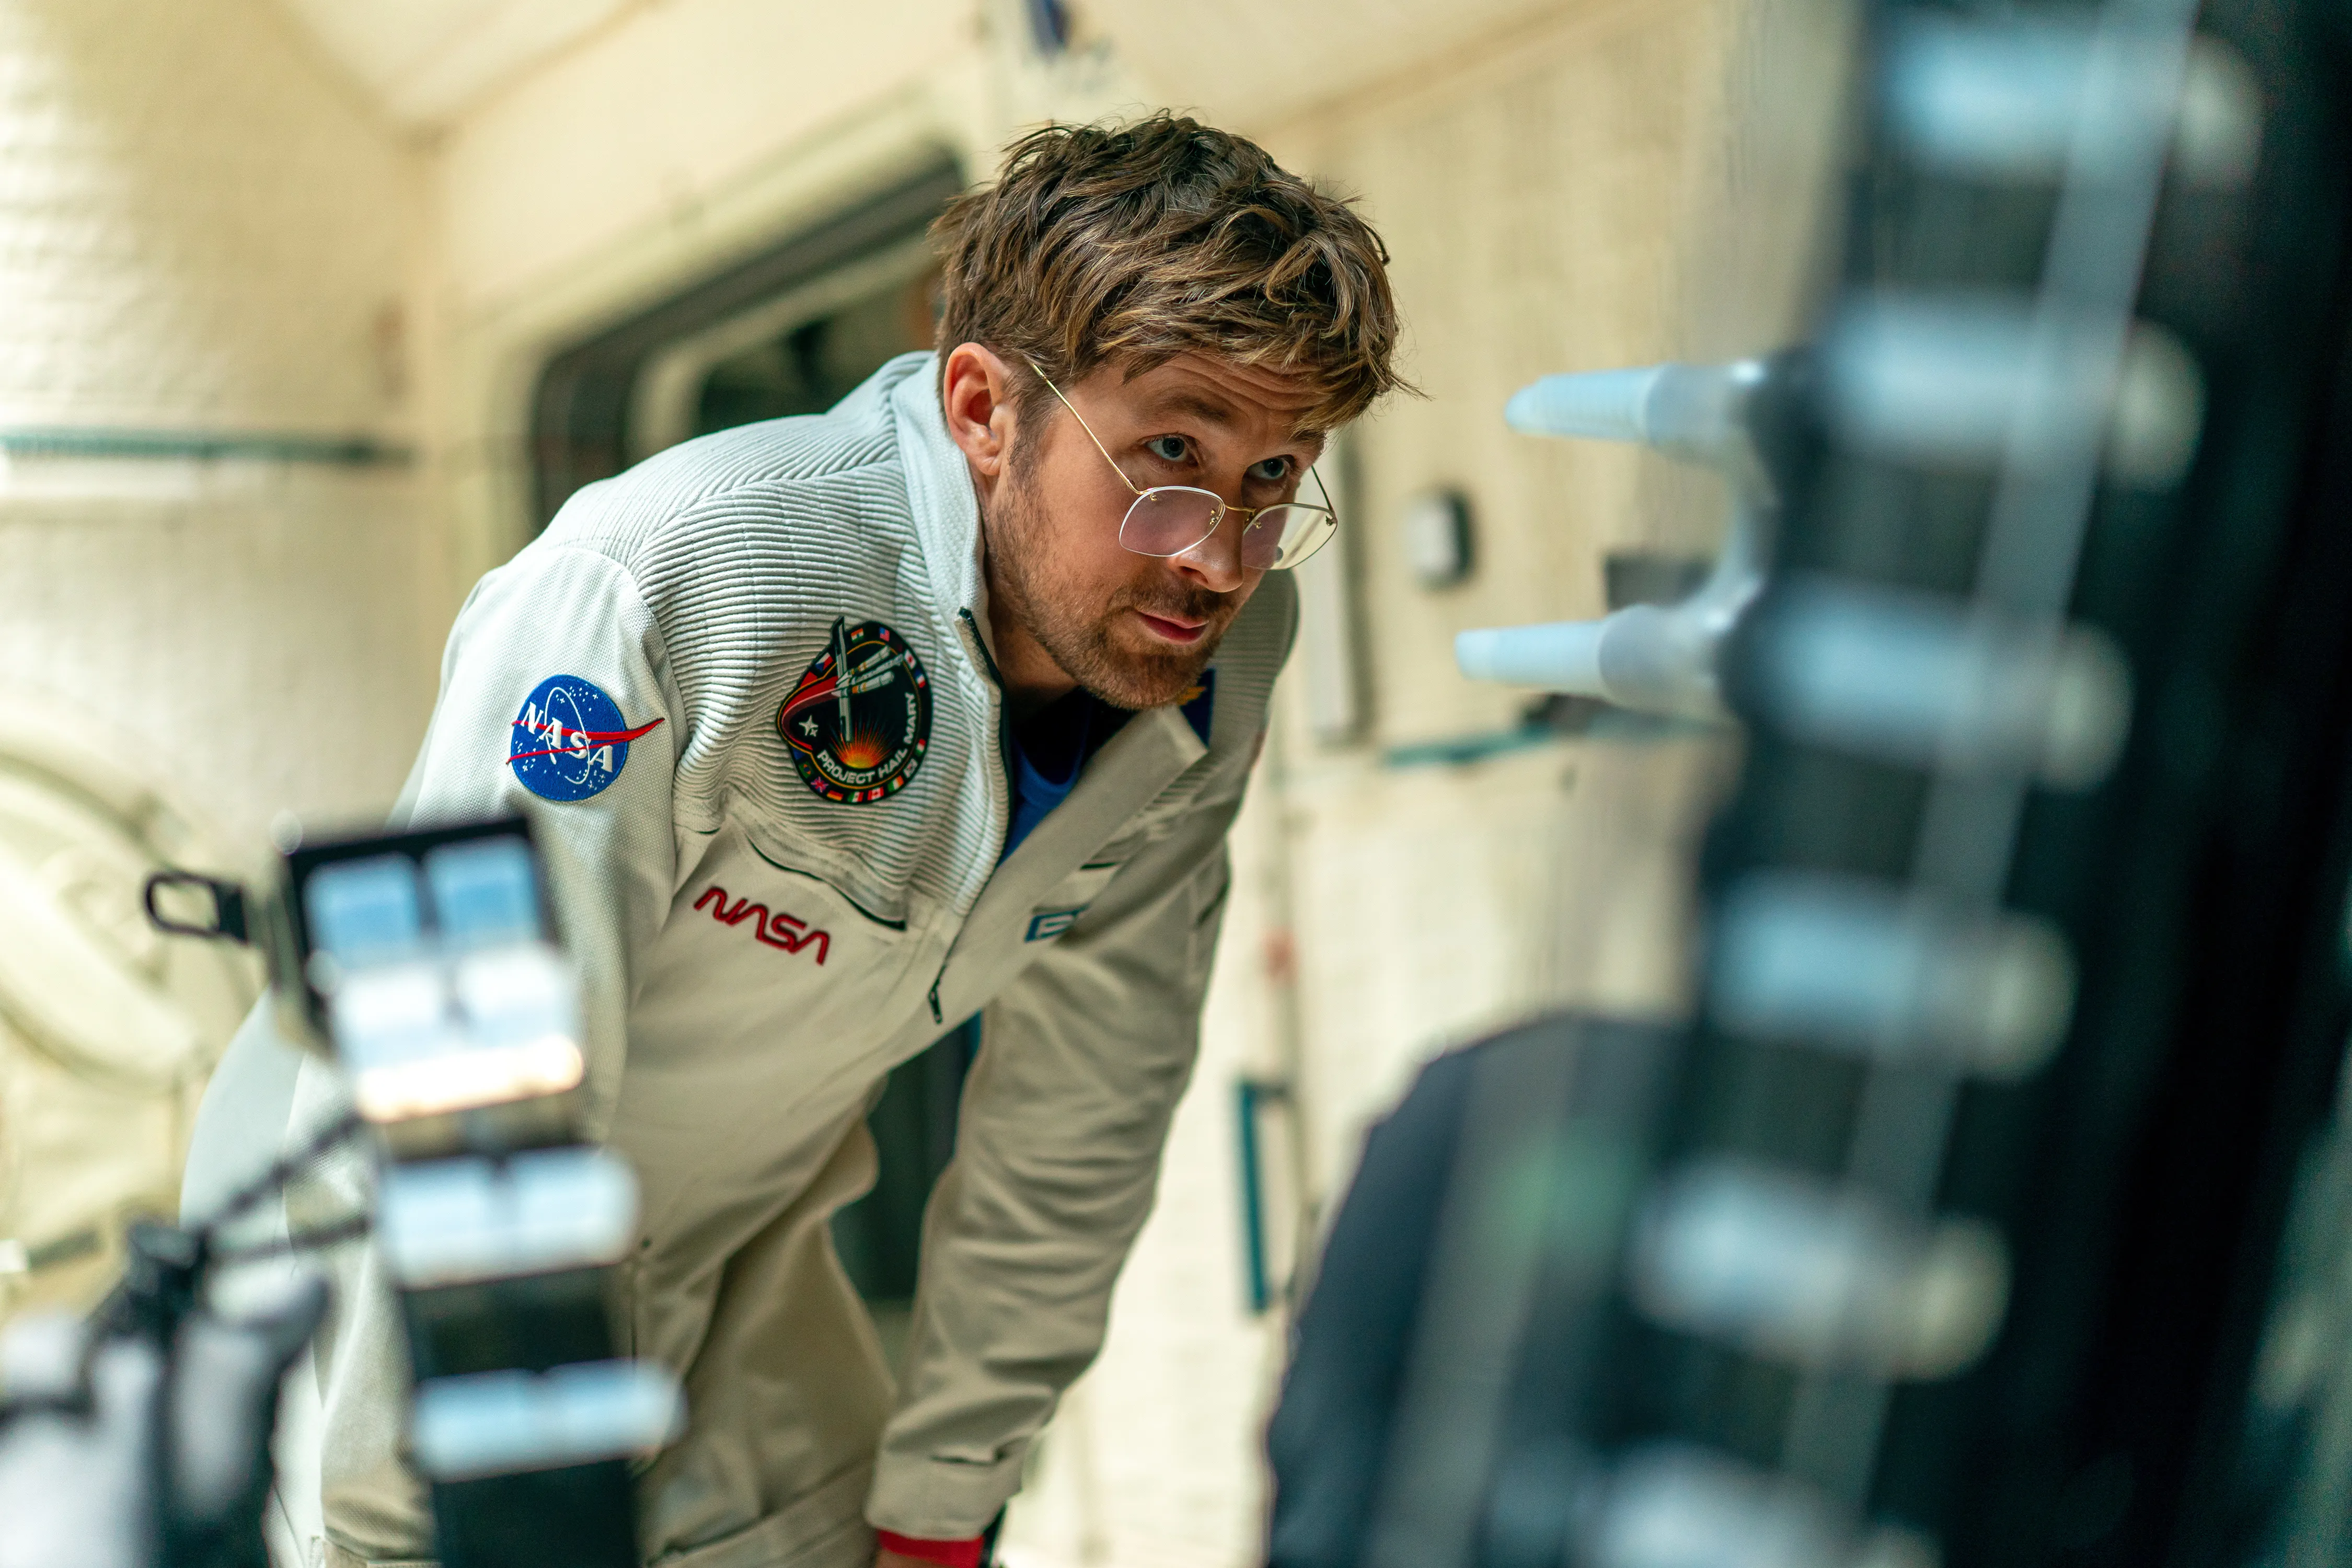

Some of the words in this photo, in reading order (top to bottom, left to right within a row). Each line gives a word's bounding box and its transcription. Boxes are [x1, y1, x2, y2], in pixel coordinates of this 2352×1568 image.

[521, 701, 613, 773] NASA
[816, 748, 876, 785] PROJECT
[878, 747, 908, 779] HAIL
[903, 691, 916, 745] MARY
[693, 886, 830, 966] NASA
